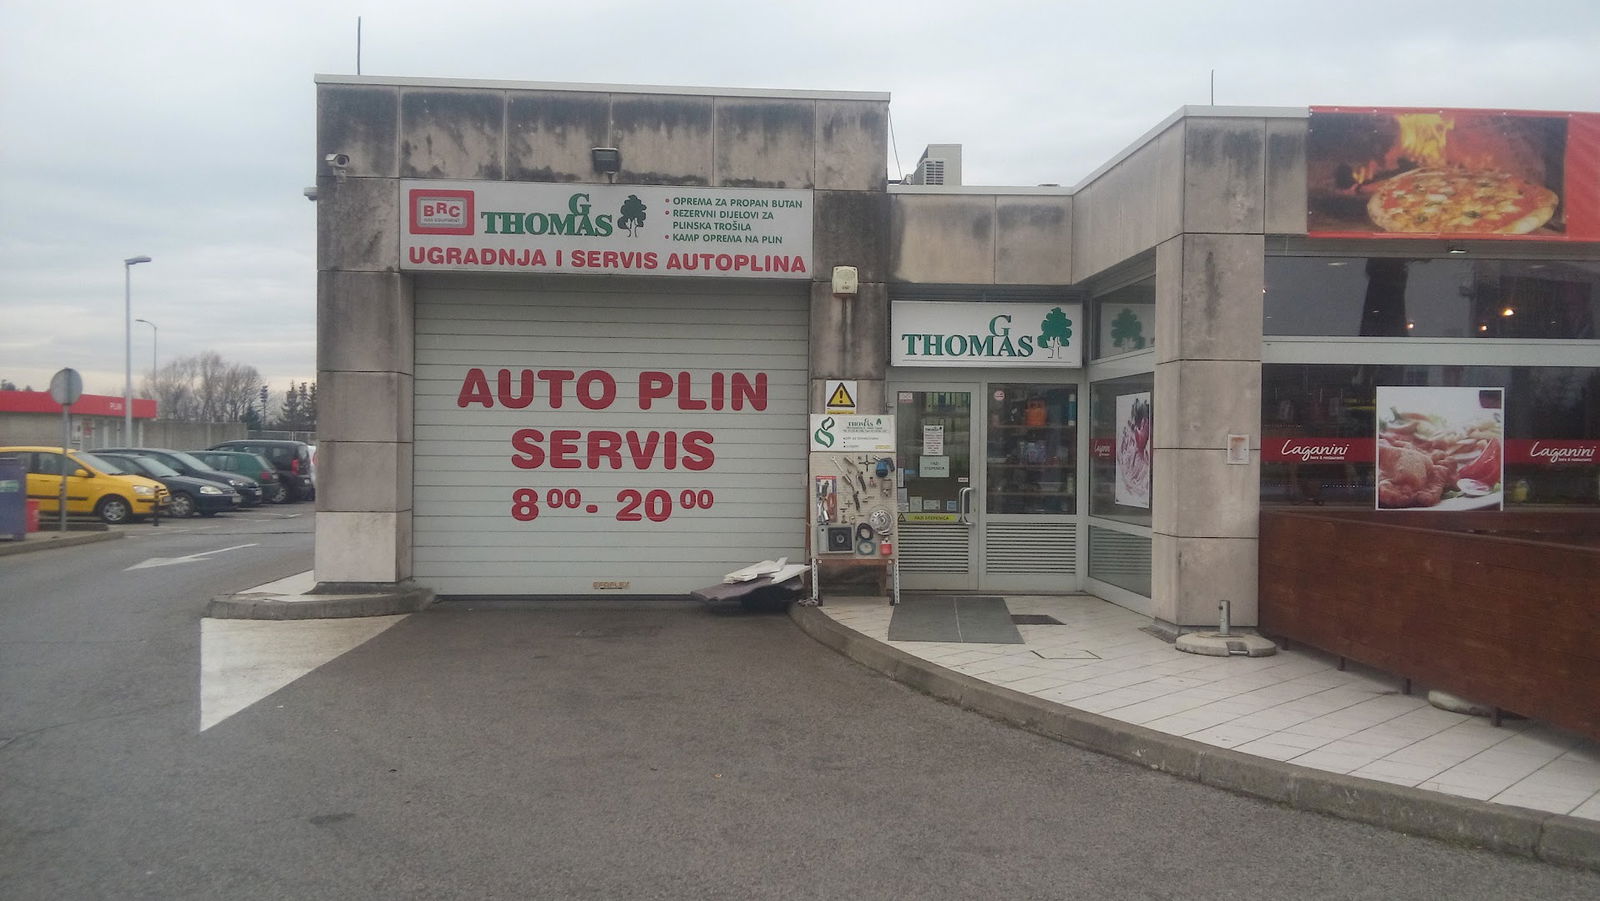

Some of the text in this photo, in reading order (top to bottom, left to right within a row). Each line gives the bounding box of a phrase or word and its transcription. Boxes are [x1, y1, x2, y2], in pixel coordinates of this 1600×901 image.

[423, 202, 461, 217] BRC
[673, 197, 802, 209] OPREMA ZA PROPAN BUTAN
[481, 211, 614, 236] THOMAS
[673, 209, 774, 220] REZERVNI DIJELOVI ZA
[673, 221, 752, 232] PLINSKA TROŠILA
[673, 233, 783, 244] KAMP OPREMA NA PLIN
[409, 247, 806, 273] UGRADNJA I SERVIS AUTOPLINA
[902, 333, 1034, 358] THOMAS
[458, 367, 768, 412] AUTO PLIN
[511, 428, 715, 471] SERVIS
[1281, 439, 1350, 461] Laganini
[1530, 440, 1597, 463] Laganini
